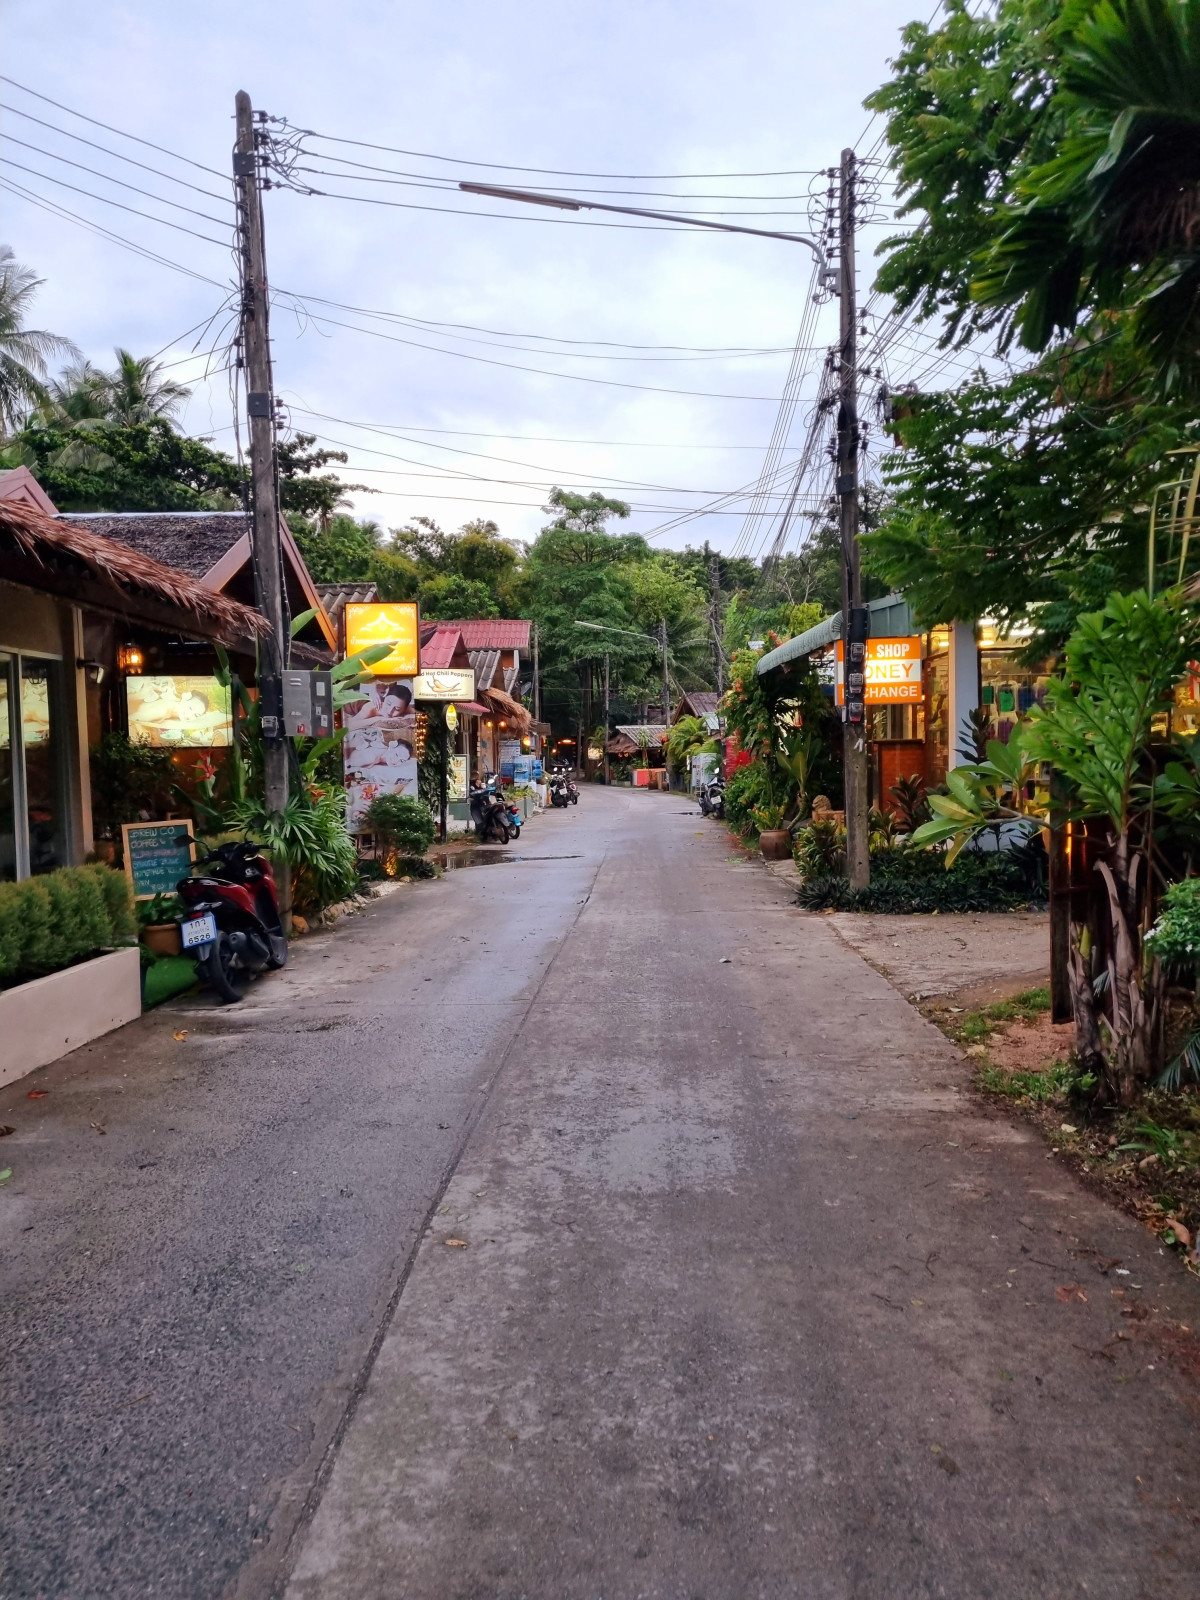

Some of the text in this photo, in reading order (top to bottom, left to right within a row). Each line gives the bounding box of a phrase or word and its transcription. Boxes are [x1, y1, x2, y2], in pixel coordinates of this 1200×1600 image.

[876, 643, 910, 658] SHOP
[450, 671, 473, 679] Peppers
[865, 663, 914, 680] ONEY
[842, 685, 918, 698] CHANGE
[188, 932, 211, 945] 6526
